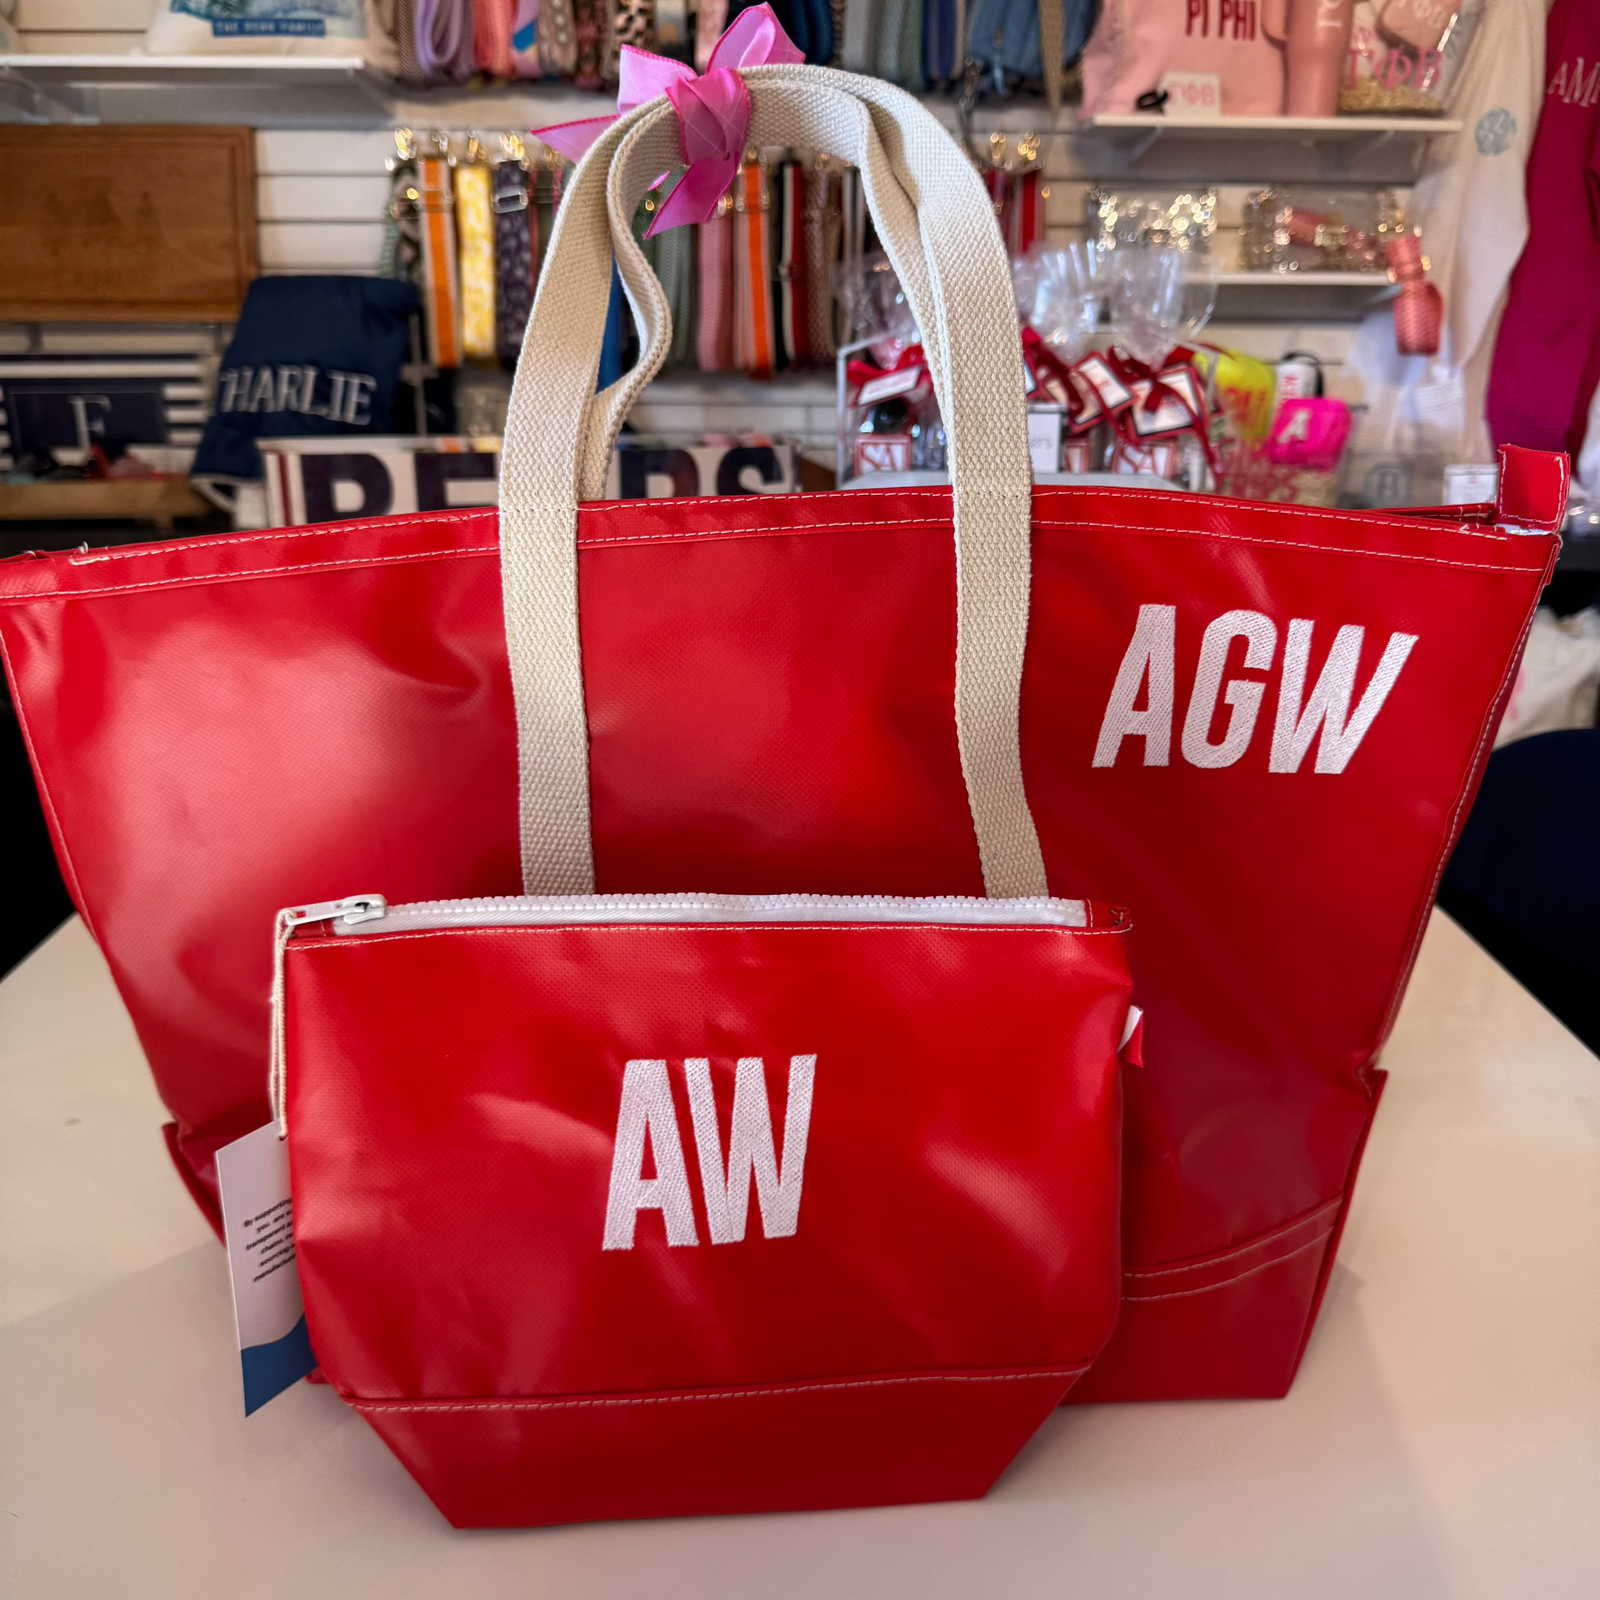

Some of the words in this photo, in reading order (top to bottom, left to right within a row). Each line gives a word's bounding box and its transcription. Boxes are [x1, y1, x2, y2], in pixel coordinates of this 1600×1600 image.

[1277, 407, 1312, 445] A
[1092, 604, 1419, 775] AGW
[602, 1053, 817, 1251] AW
